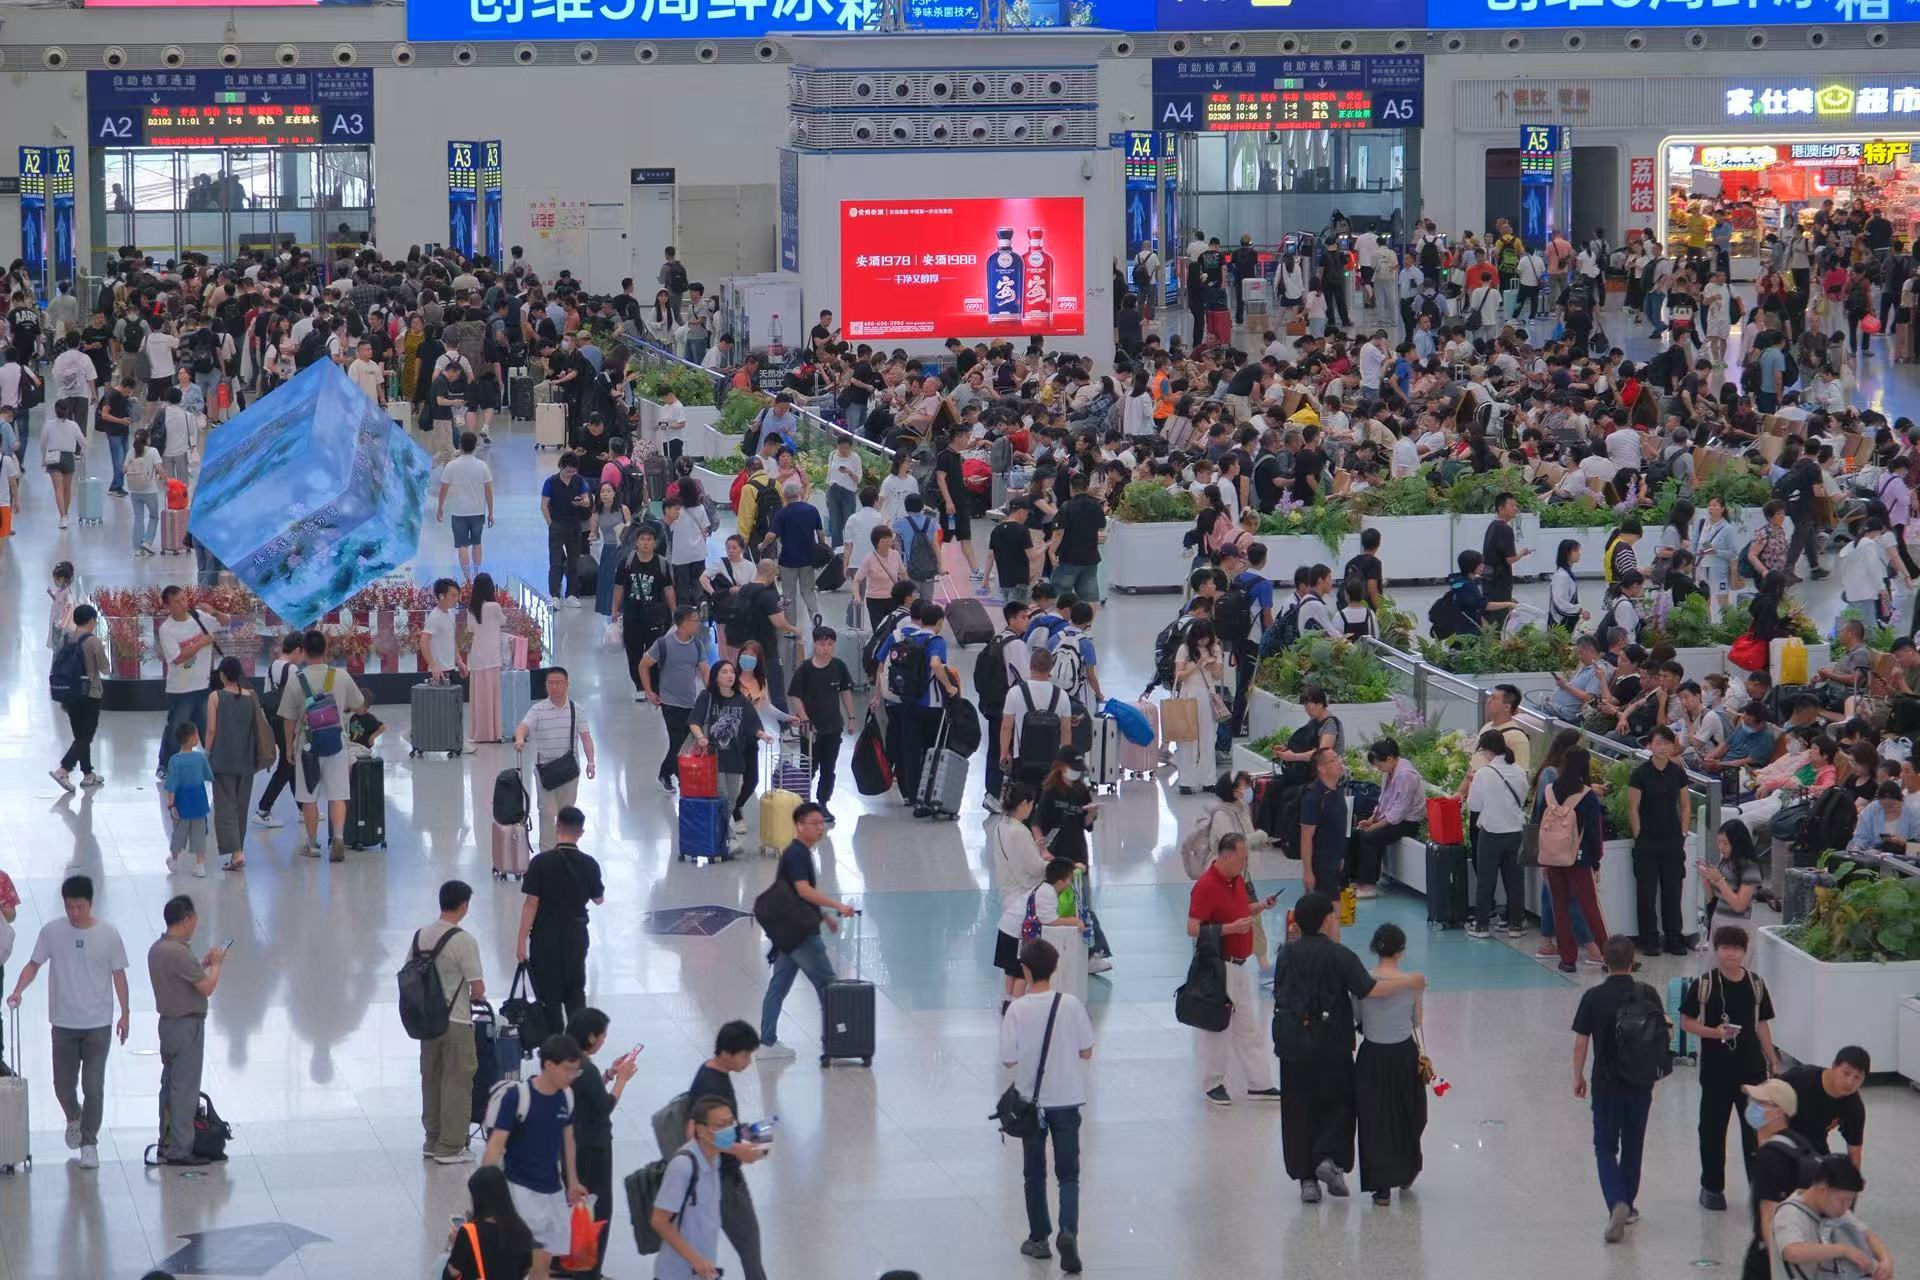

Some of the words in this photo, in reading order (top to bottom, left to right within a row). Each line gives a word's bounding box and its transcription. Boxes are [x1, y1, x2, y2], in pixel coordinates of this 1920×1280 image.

[1178, 61, 1257, 73] 自助检票通道
[1283, 60, 1361, 71] 自助检票通道
[113, 74, 196, 86] 自助检票通道
[224, 73, 306, 85] 自助检票通道
[1163, 102, 1194, 122] A4
[1312, 101, 1329, 110] 黄色
[1338, 110, 1371, 118] 正在检票
[1383, 99, 1413, 119] A5
[100, 117, 133, 138] A2
[148, 118, 173, 126] D2102
[176, 117, 200, 126] 11:01
[227, 117, 243, 125] 1-6
[256, 115, 276, 125] 黄色
[284, 115, 319, 125] 正在候车
[331, 113, 364, 135] A3
[1132, 137, 1152, 157] A4
[1528, 132, 1548, 151] A5
[25, 154, 40, 174] A2
[57, 153, 70, 173] A2
[454, 148, 471, 168] A3
[487, 147, 498, 167] A3
[1863, 142, 1910, 166] 特产
[1632, 159, 1652, 210] 荔枝
[856, 254, 911, 267] 安酒1978
[922, 253, 977, 266] 安酒1988
